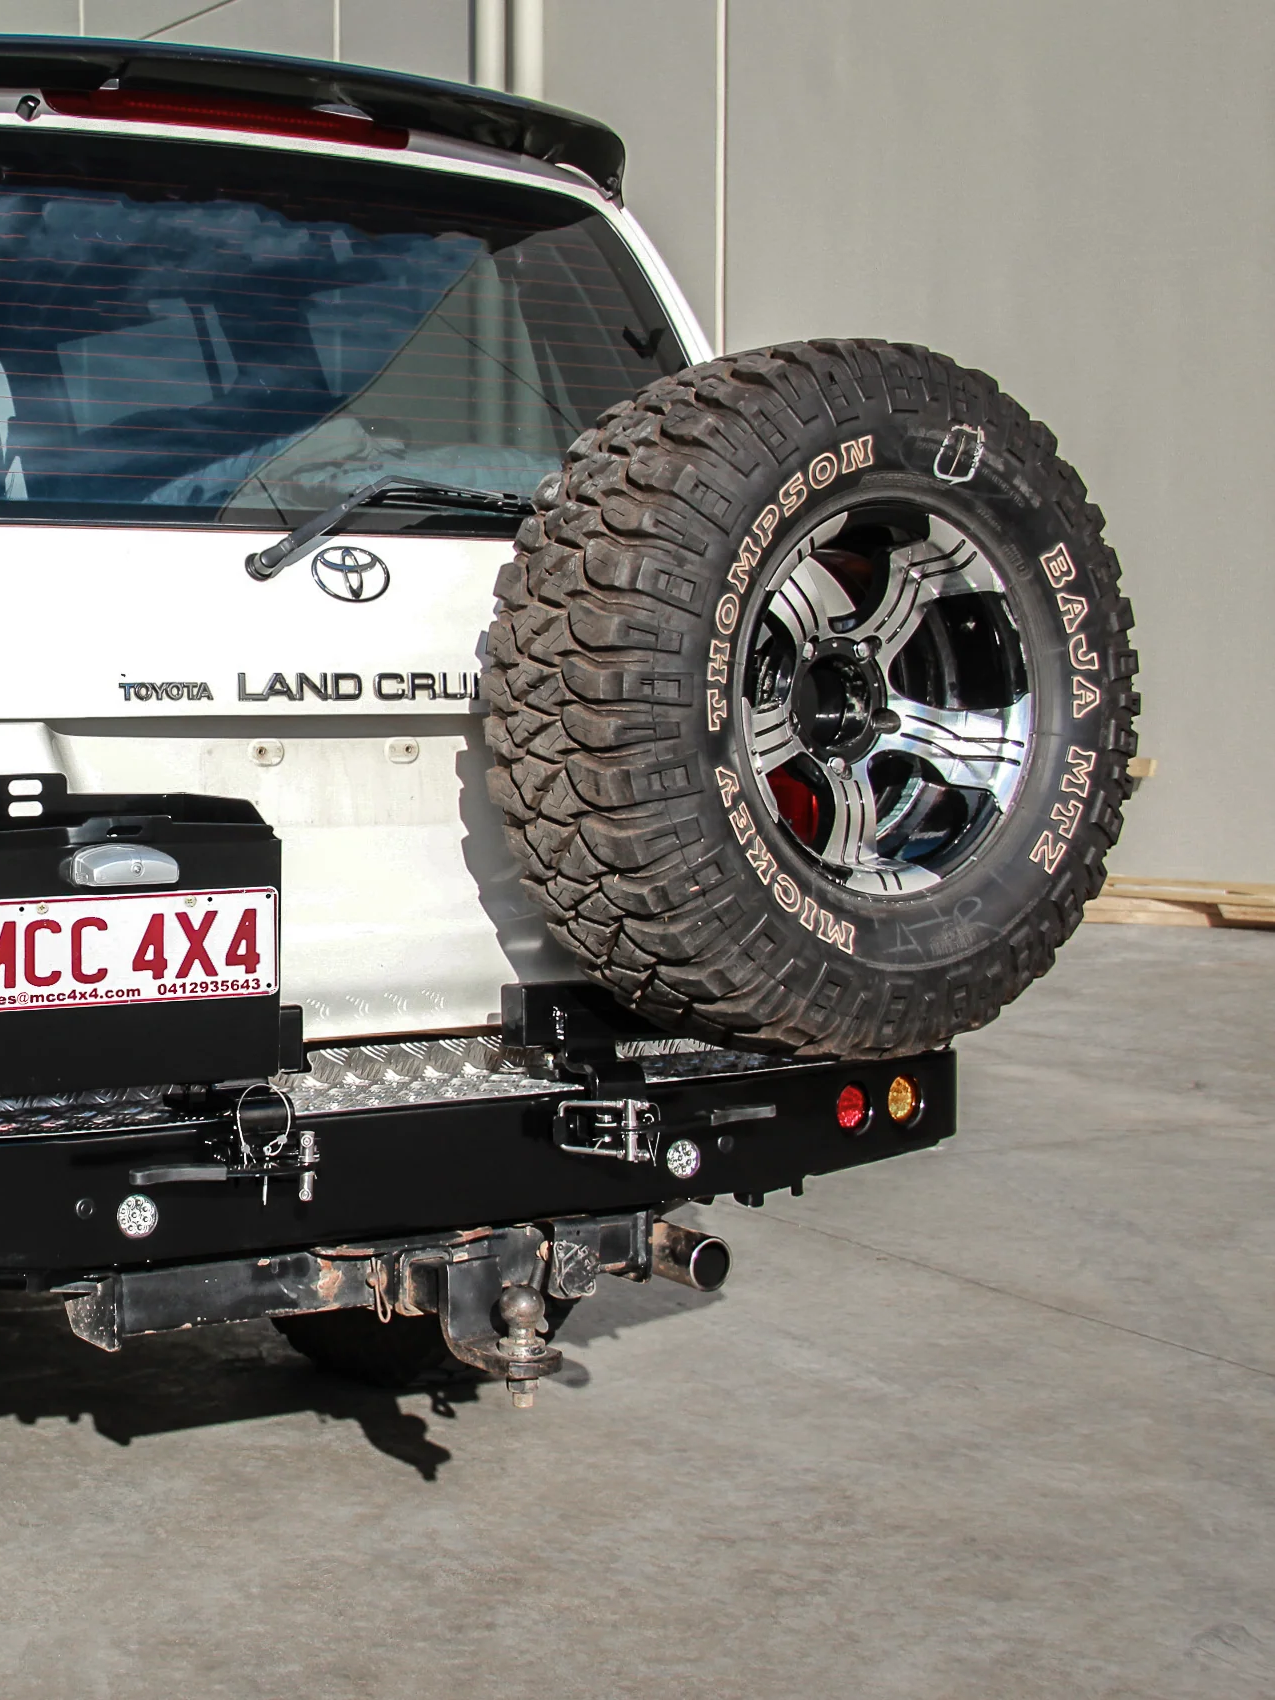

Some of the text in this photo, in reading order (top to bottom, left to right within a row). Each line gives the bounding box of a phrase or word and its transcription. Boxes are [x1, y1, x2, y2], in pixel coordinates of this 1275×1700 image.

[118, 682, 214, 701] TOYOTA
[237, 672, 480, 701] LAND CRUI
[706, 435, 874, 955] MICKEY THOMPSON
[1028, 542, 1100, 875] BAJA MTZ
[132, 908, 261, 979] 4X4
[157, 978, 261, 997] 0412935643
